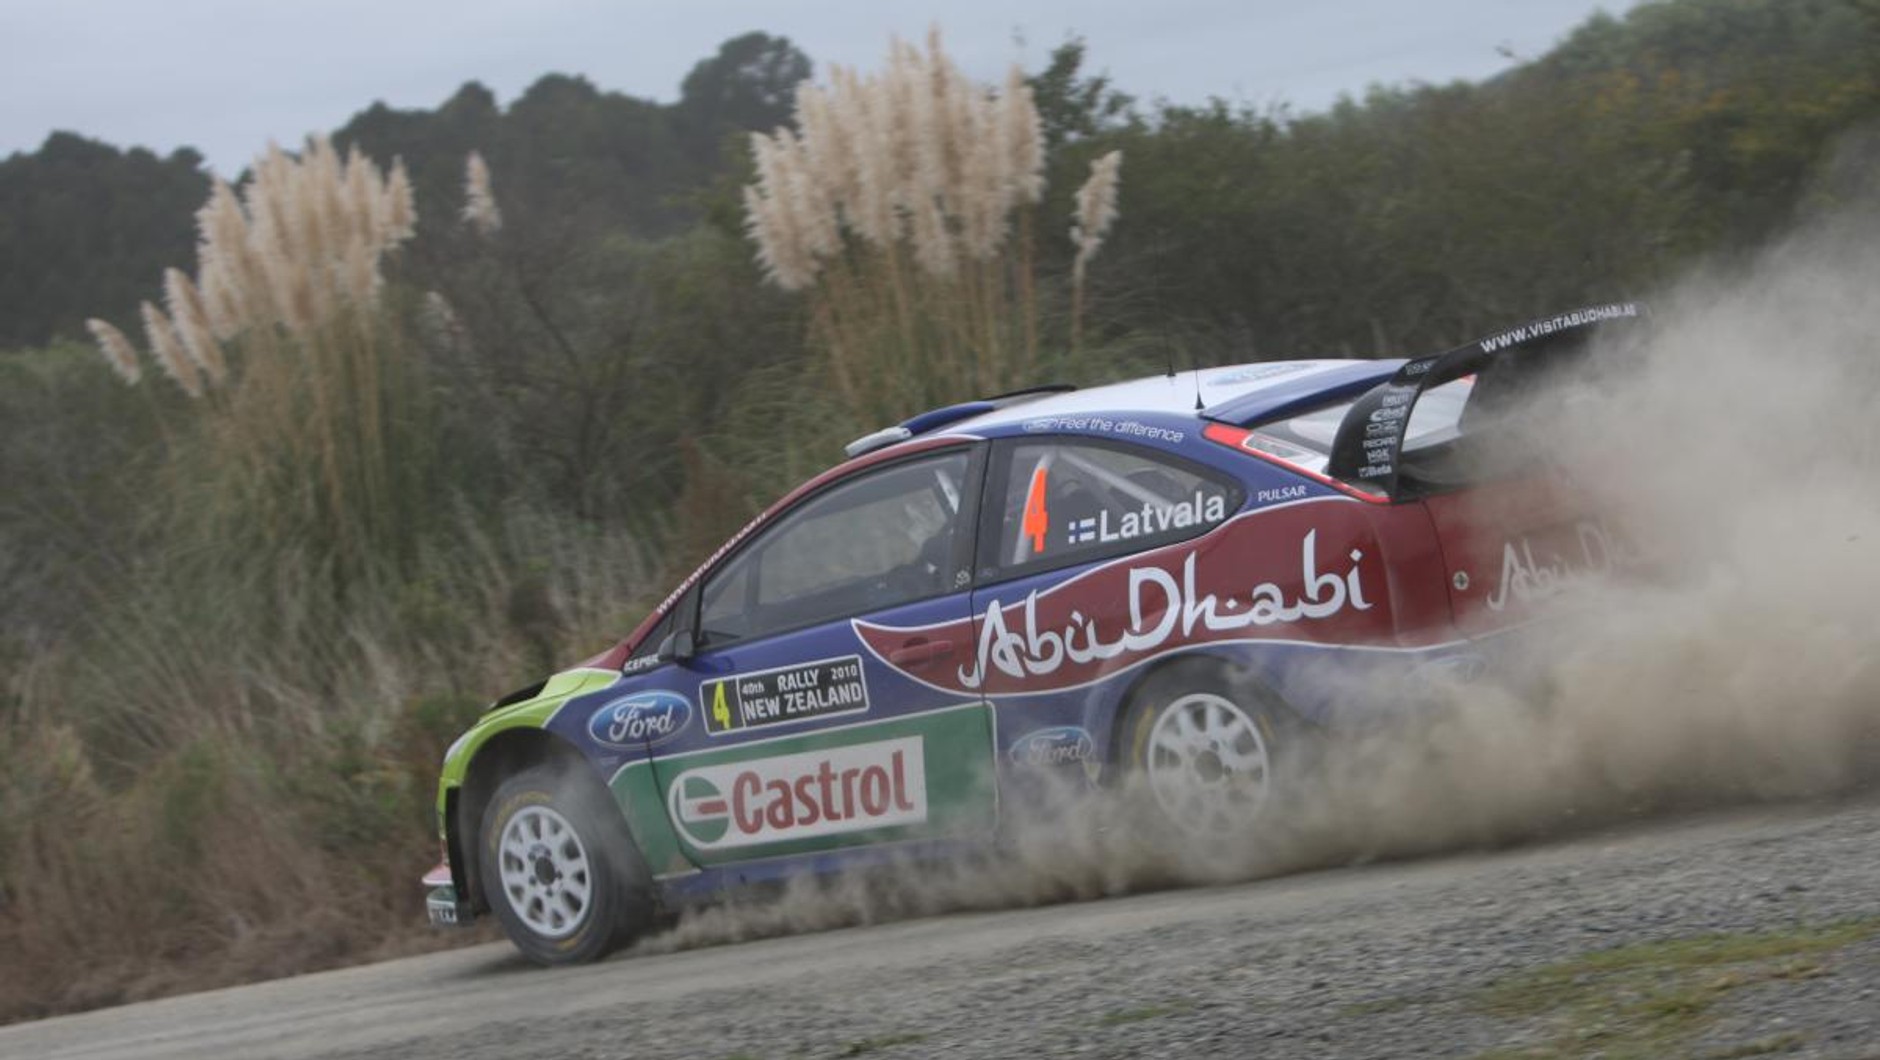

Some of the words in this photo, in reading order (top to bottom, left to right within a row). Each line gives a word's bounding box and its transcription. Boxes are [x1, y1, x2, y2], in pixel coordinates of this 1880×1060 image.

[1057, 417, 1090, 430] Feel
[1090, 417, 1113, 431] the
[1114, 419, 1185, 443] difference
[1022, 468, 1048, 553] 4
[1257, 485, 1307, 502] PULSAR
[1099, 491, 1225, 542] Latvala
[741, 681, 765, 695] 40th
[777, 669, 820, 692] RALLY
[830, 664, 858, 680] 2010
[608, 699, 677, 742] Ford
[713, 681, 731, 729] 4
[743, 698, 781, 720] NEW
[785, 682, 863, 713] ZEALAND
[1027, 732, 1085, 764] Ford
[732, 750, 915, 835] Castrol
